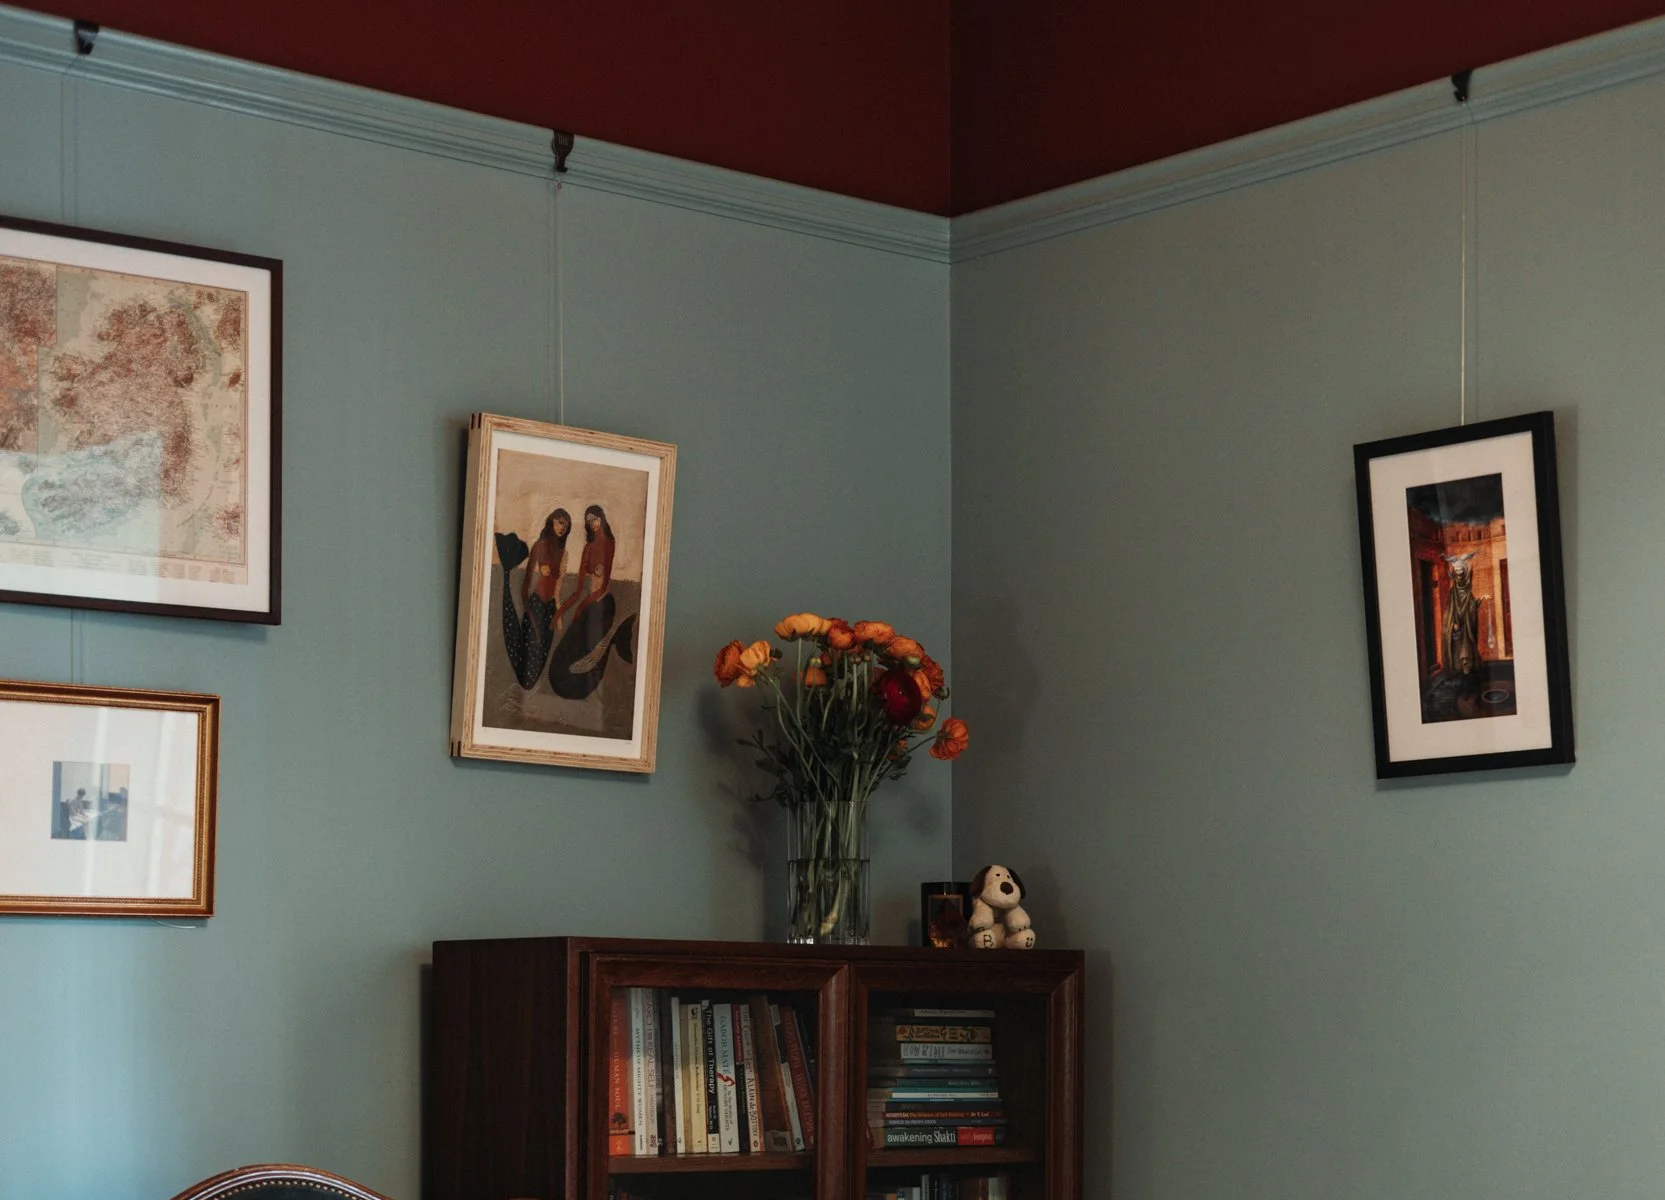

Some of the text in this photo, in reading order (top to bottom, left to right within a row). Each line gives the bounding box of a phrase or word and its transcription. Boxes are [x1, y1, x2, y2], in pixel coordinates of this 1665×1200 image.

[719, 1016, 728, 1049] GABOR
[707, 1047, 714, 1056] of
[707, 1059, 716, 1094] Therapy
[747, 1078, 756, 1101] ALAIN
[750, 1111, 758, 1137] BOTTON
[888, 1132, 933, 1144] awakening
[934, 1130, 956, 1143] Shakti
